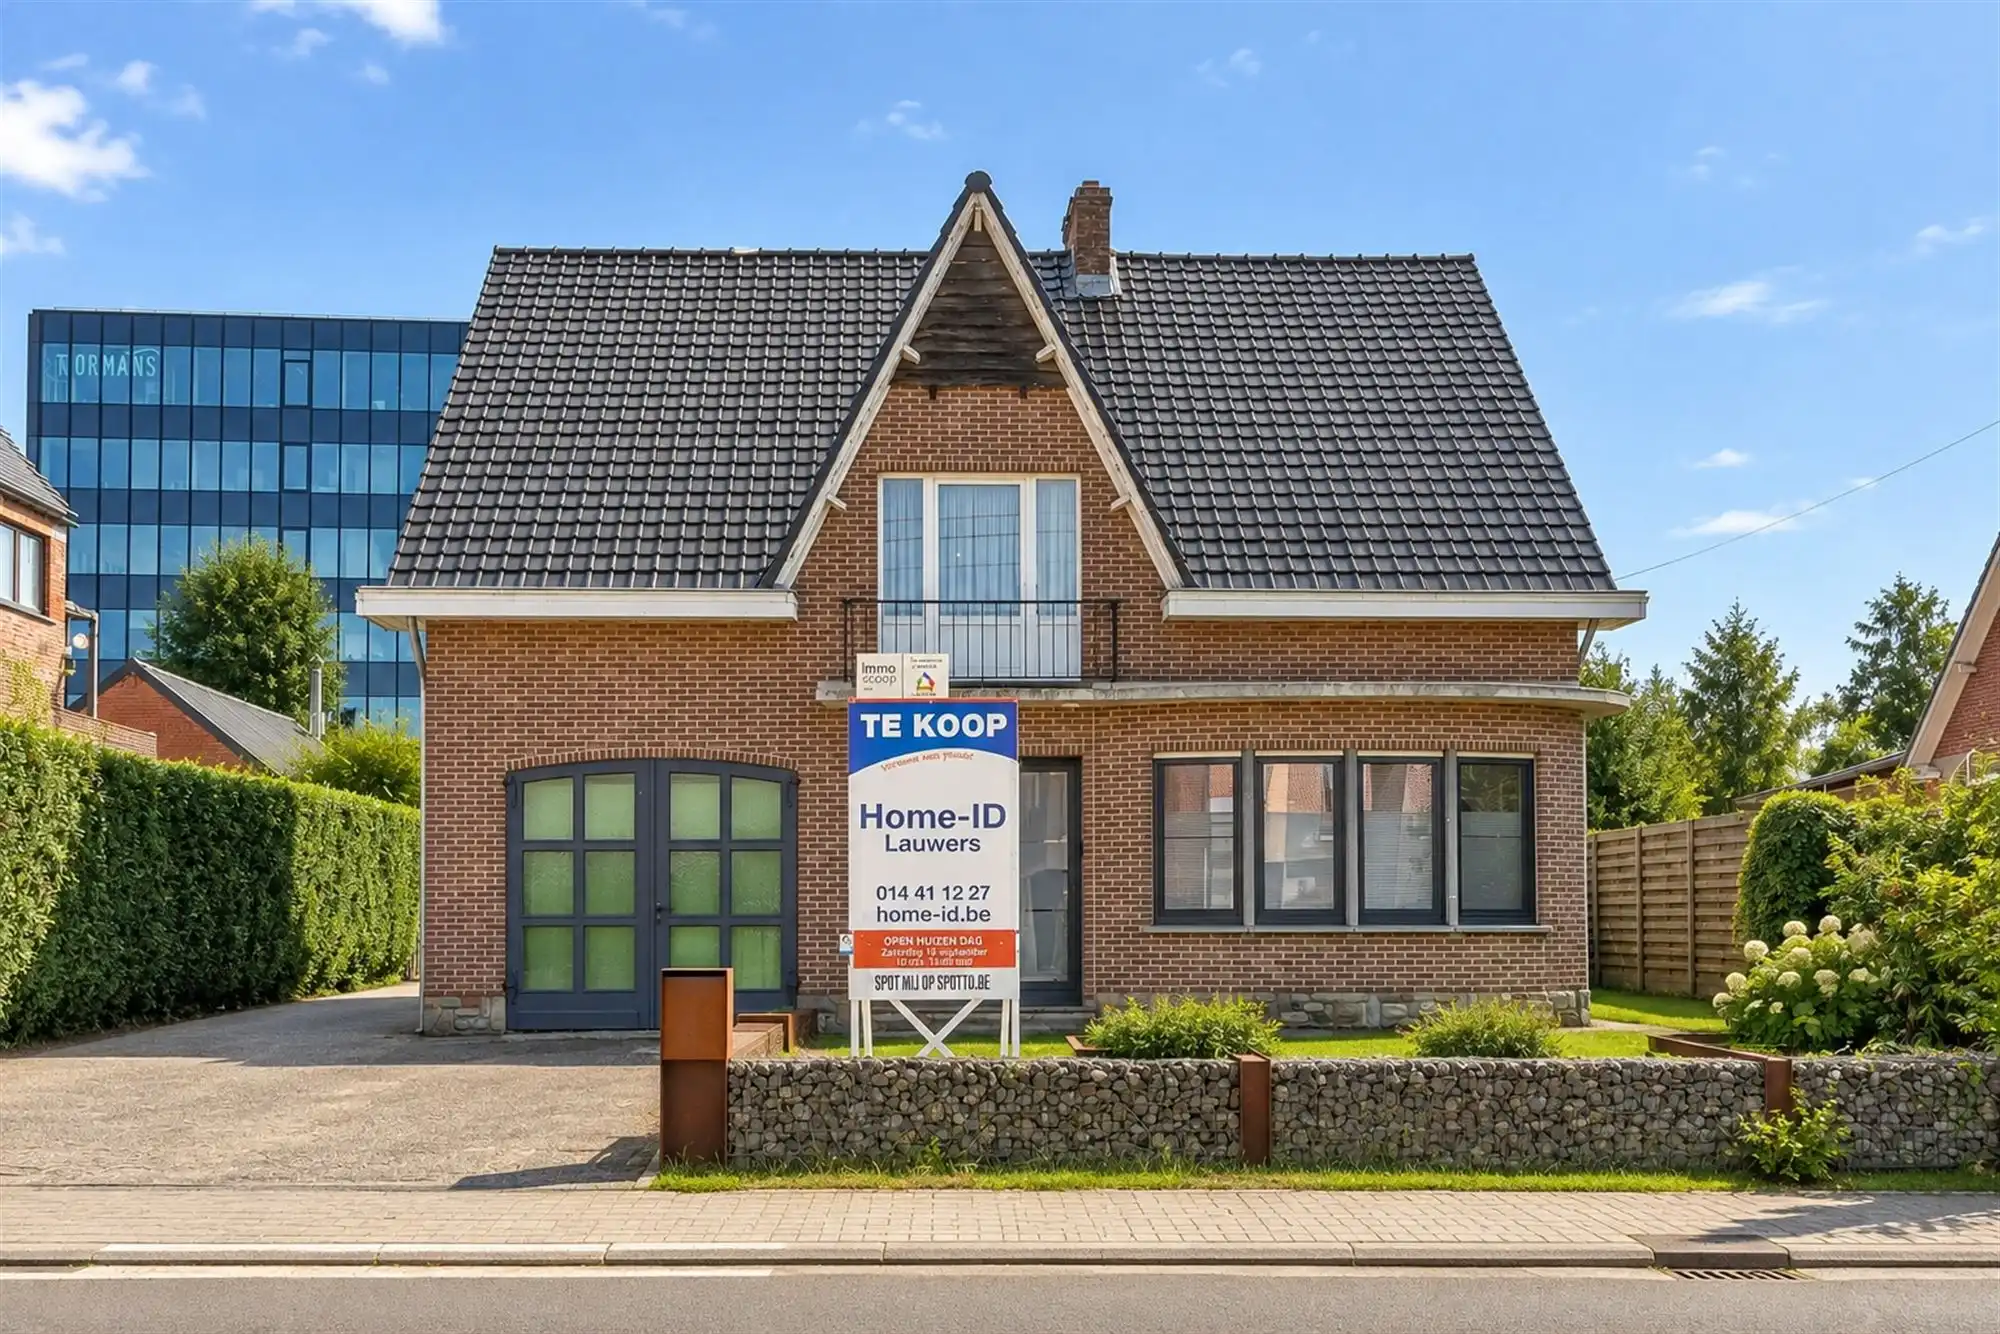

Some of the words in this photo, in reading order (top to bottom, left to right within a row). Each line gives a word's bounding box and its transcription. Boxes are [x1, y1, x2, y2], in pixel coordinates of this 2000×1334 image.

[862, 662, 896, 674] Immo
[860, 713, 902, 738] TE
[913, 713, 1008, 738] KOOP
[860, 803, 1007, 829] Home-ID
[885, 834, 981, 852] Lauwers
[876, 885, 909, 901] 014
[914, 885, 934, 901] 41
[942, 885, 963, 901] 12
[968, 885, 991, 901] 27
[876, 906, 991, 922] home-id.be
[883, 936, 913, 946] OPEN
[959, 936, 983, 946] DAG
[874, 974, 900, 991] SPOT
[902, 974, 919, 991] MIJ
[922, 974, 935, 991] OP
[937, 974, 991, 991] SPOTTO.BE
